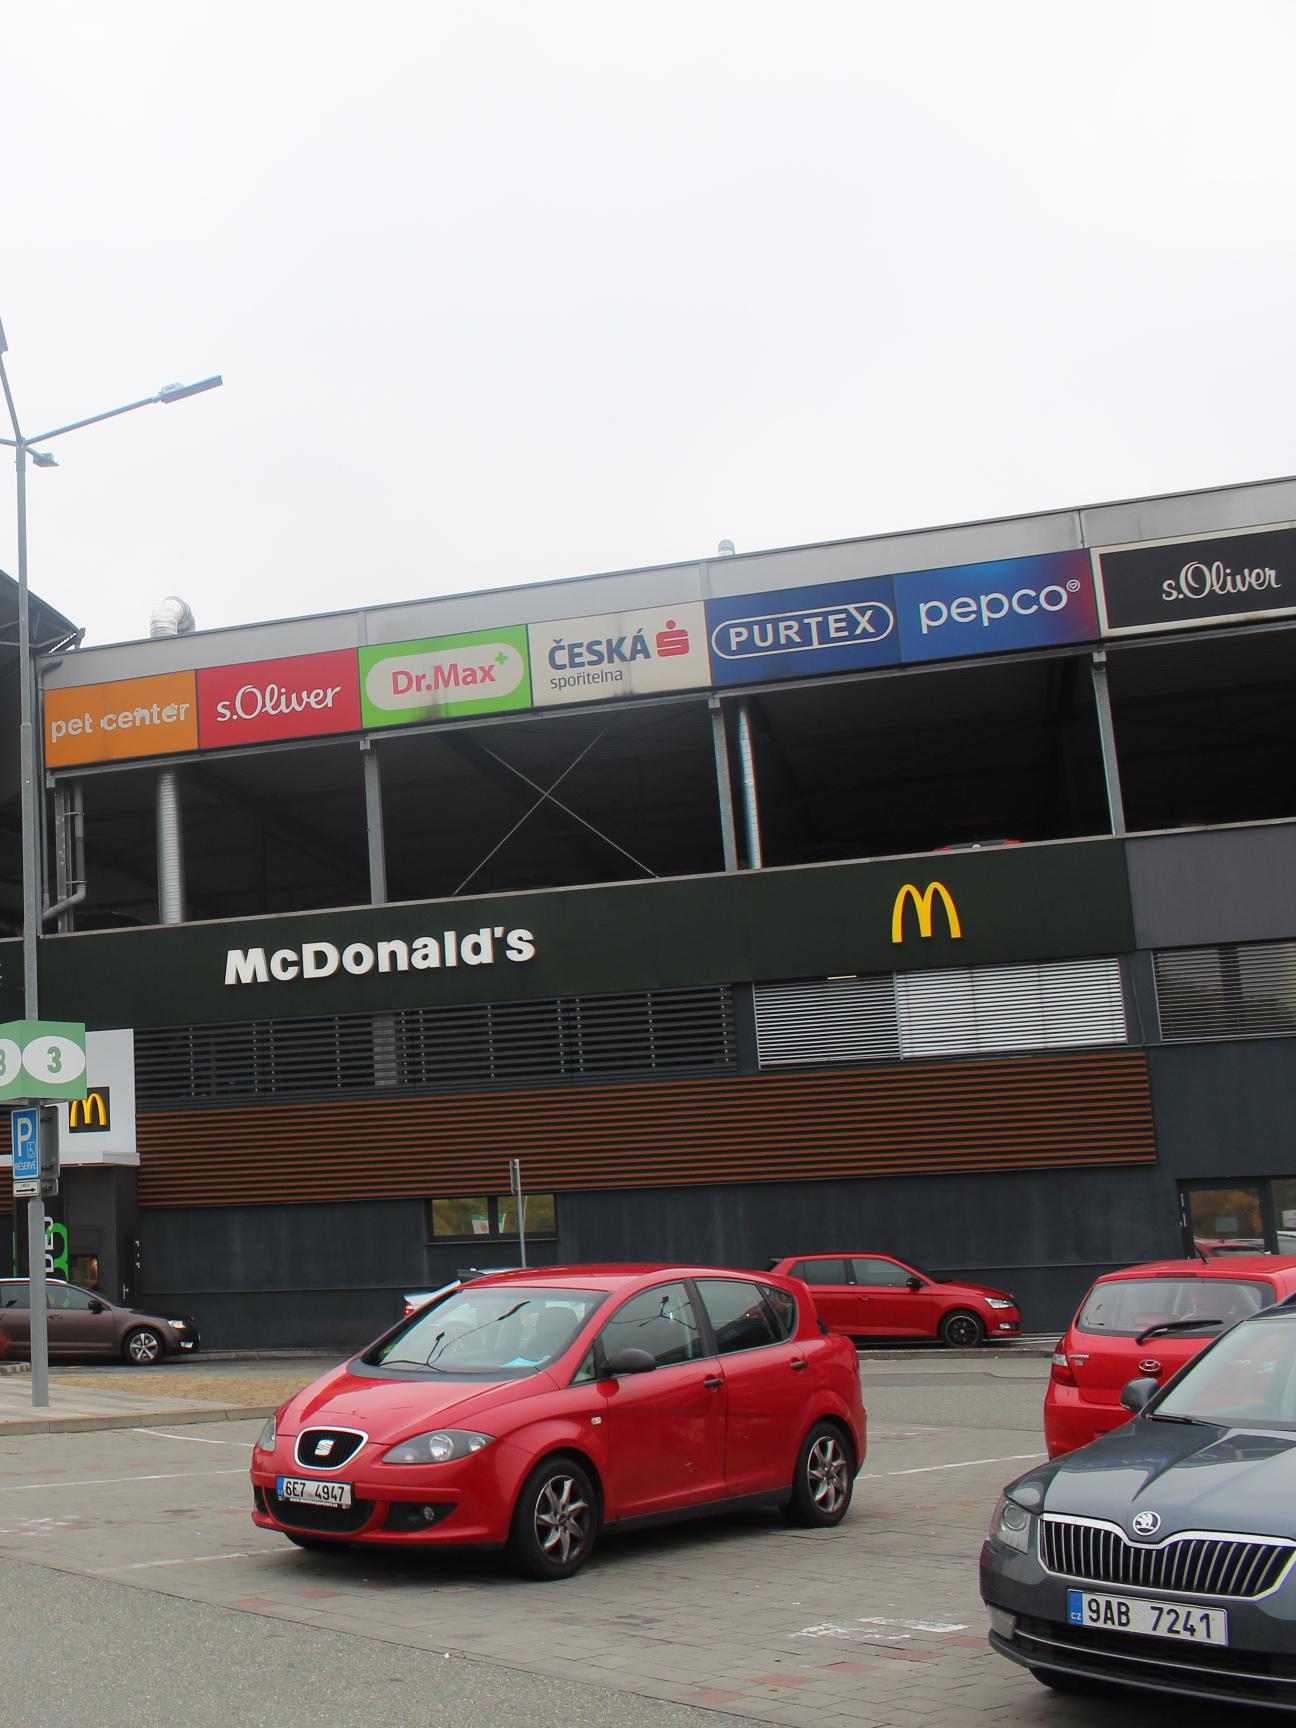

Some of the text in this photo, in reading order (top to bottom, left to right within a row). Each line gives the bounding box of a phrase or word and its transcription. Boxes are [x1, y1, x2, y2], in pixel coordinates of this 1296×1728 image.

[1162, 561, 1281, 601] s.Oliver
[729, 608, 876, 650] PURTEX
[919, 585, 1068, 635] pepco
[548, 628, 652, 671] ČESKÁ
[392, 663, 497, 696] Dr.Max
[549, 669, 623, 691] spořitelna
[51, 703, 190, 743] pet center
[216, 684, 342, 722] s.Oliver
[225, 927, 535, 985] McDonald's
[46, 1045, 62, 1074] 3
[17, 1117, 33, 1157] P
[285, 1480, 345, 1502] 6E7 4947
[1071, 1611, 1083, 1621] CZ
[1088, 1598, 1211, 1639] 9AB 7241
